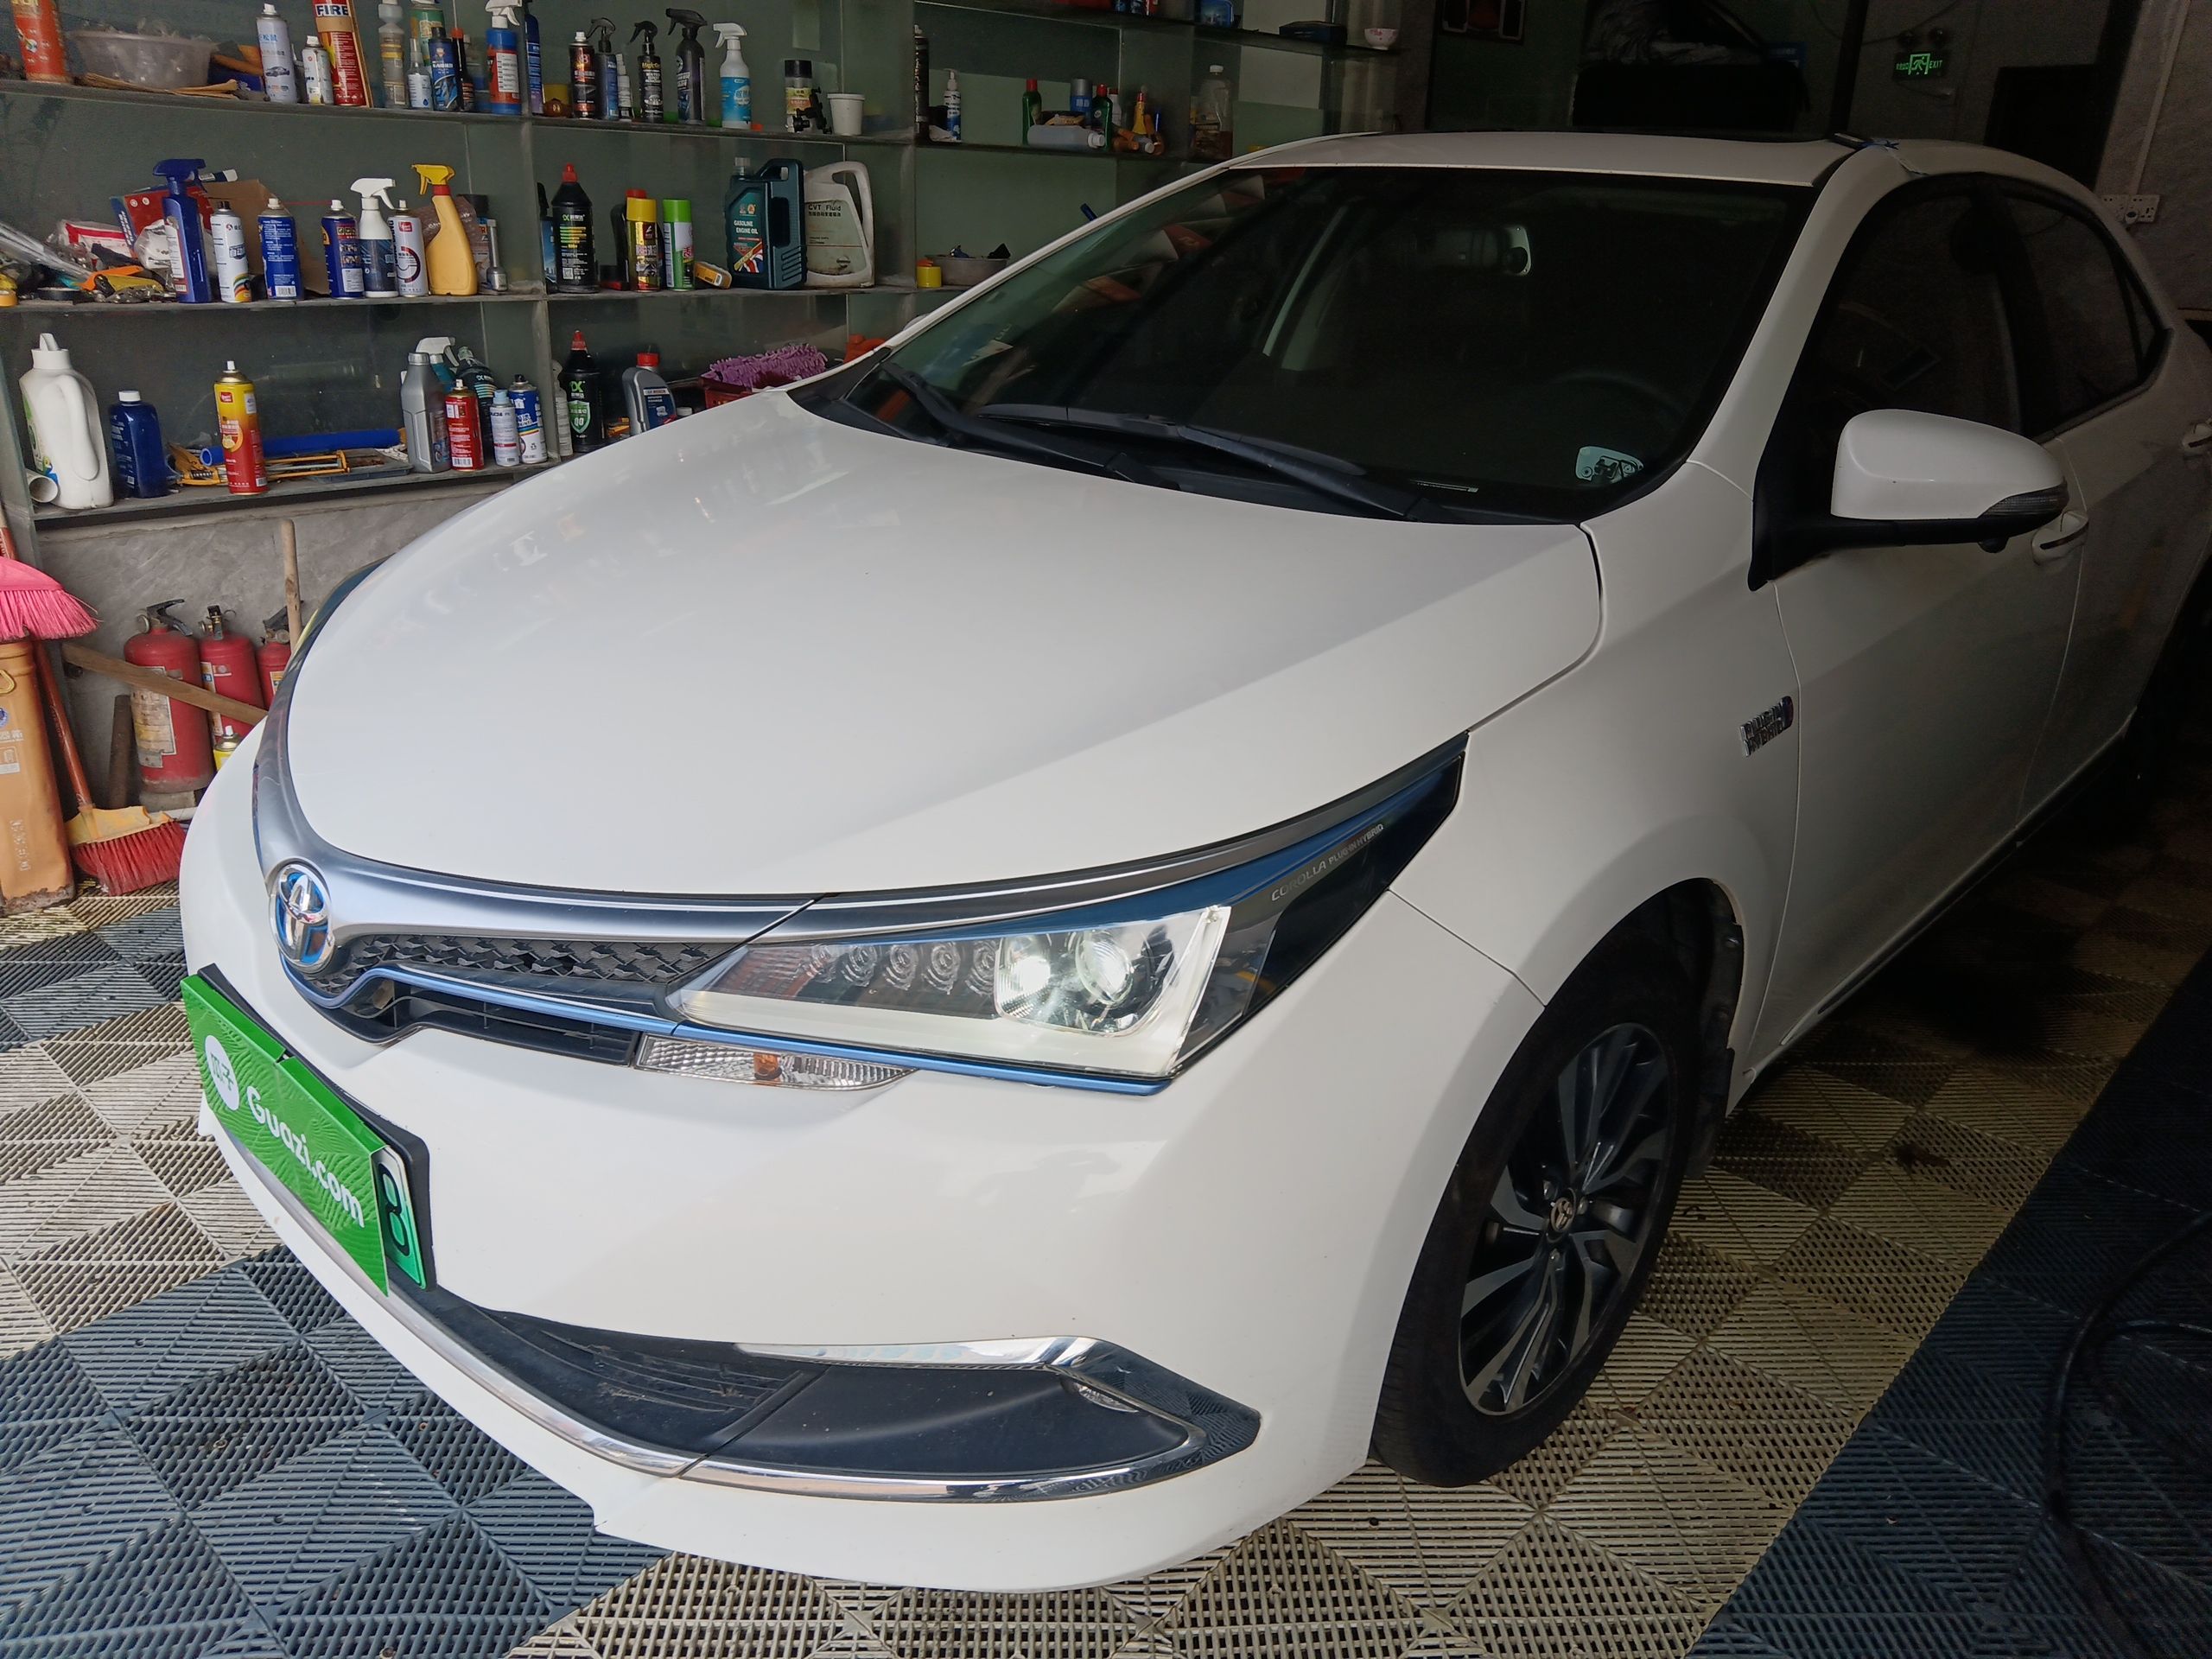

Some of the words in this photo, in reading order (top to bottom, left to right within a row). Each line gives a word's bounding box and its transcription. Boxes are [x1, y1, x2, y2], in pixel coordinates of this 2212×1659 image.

[316, 5, 349, 16] FIRE
[1929, 60, 1943, 69] EXIT
[1271, 861, 1327, 901] COROLLA
[1328, 842, 1357, 865] PLUG-IN
[1357, 823, 1384, 847] HYBRID
[246, 1086, 365, 1229] Guazi.com
